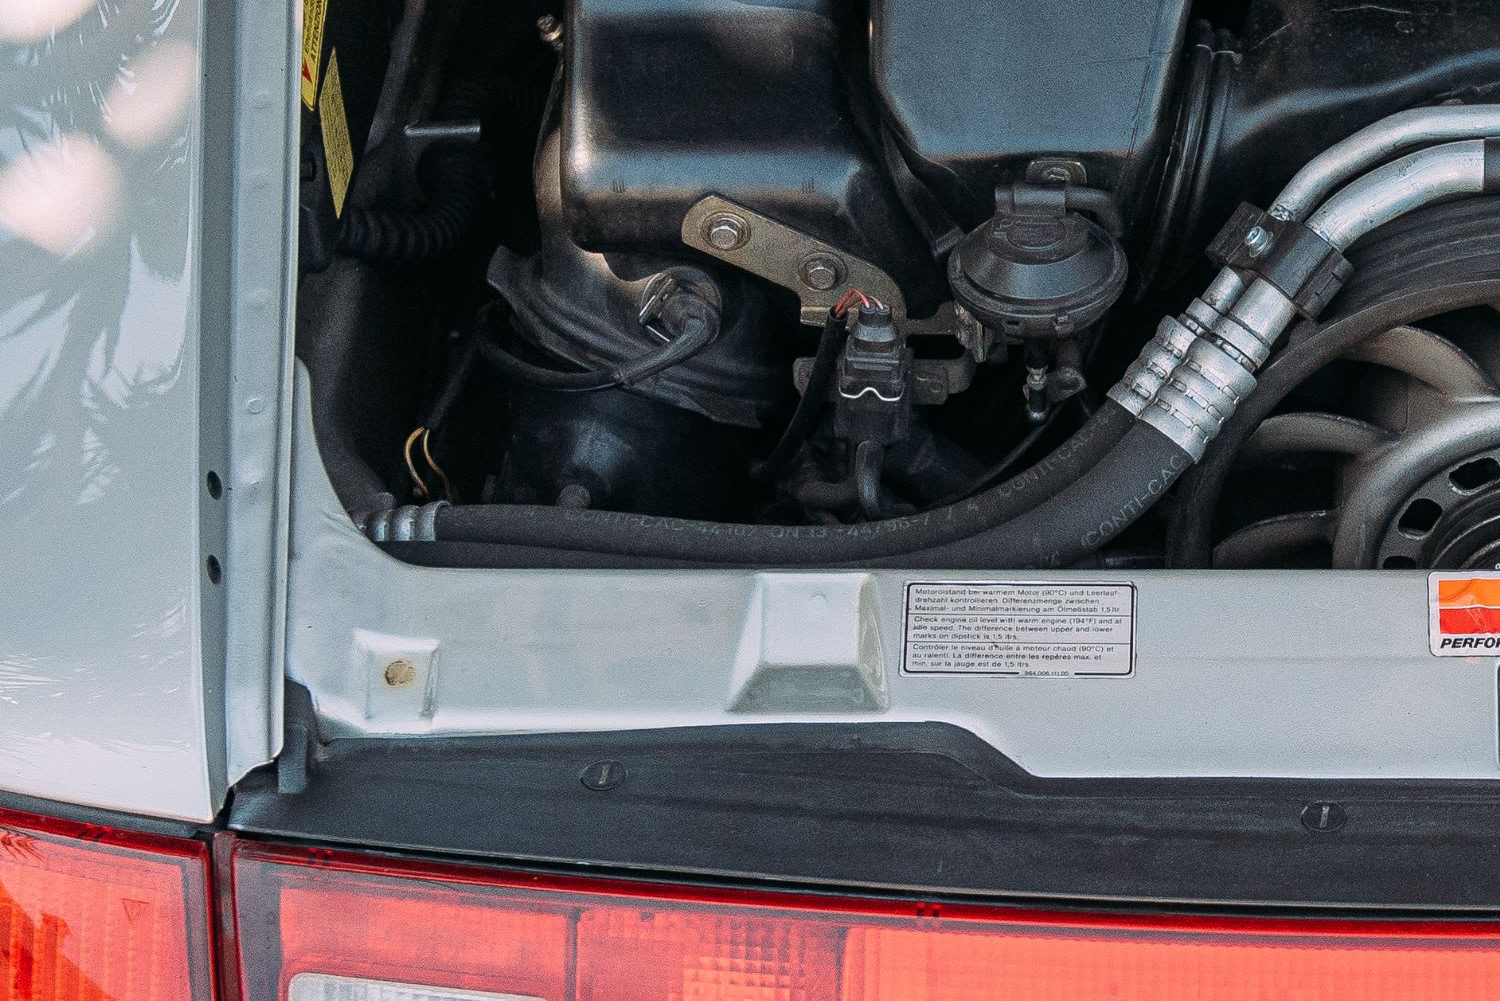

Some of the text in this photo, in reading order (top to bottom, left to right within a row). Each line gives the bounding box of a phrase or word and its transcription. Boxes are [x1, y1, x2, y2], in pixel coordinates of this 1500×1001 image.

[1041, 617, 1067, 625] engine
[951, 633, 981, 641] dipstick
[953, 661, 975, 669] jauge
[1004, 661, 1015, 669] 1,5
